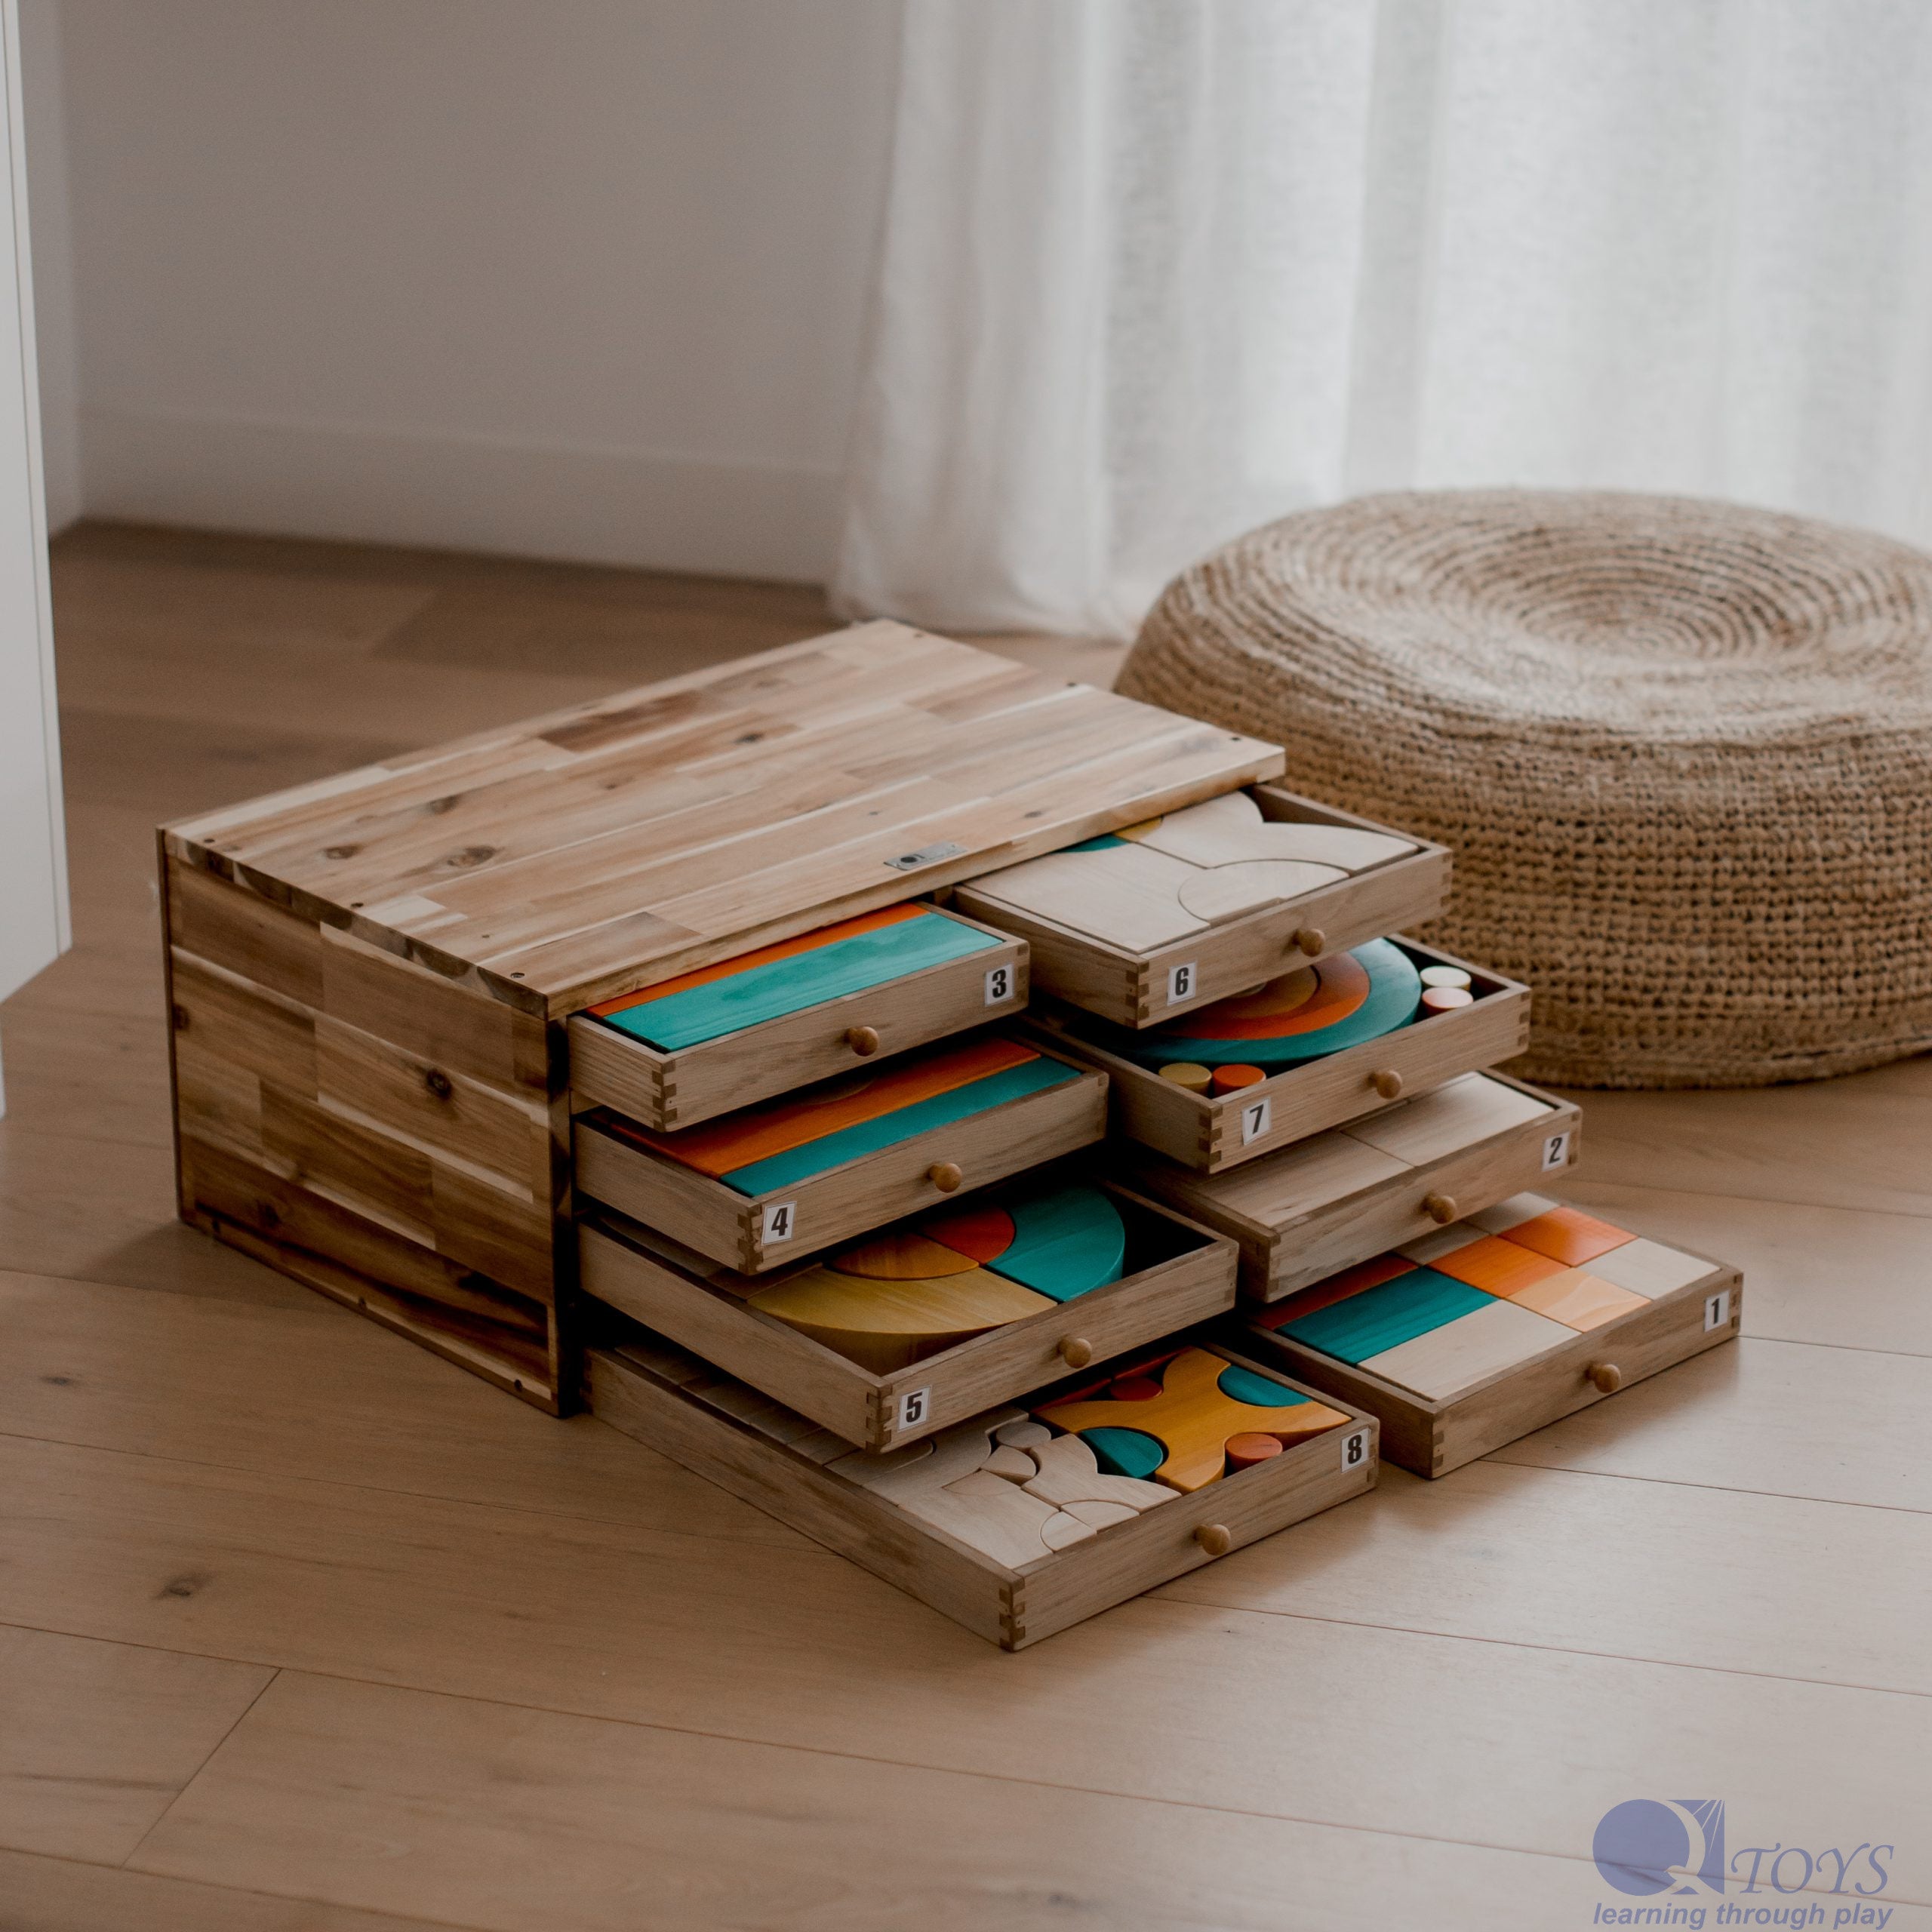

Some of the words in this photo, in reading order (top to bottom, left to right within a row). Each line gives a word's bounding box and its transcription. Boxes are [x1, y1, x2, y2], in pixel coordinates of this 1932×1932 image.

[992, 968, 1007, 998] 3
[1174, 967, 1189, 996] 6
[1249, 1103, 1265, 1135] 7
[1548, 1137, 1563, 1164] 2
[771, 1207, 788, 1237] 4
[1711, 1297, 1720, 1325] 1
[906, 1391, 923, 1423] 5
[1347, 1434, 1362, 1465] 8
